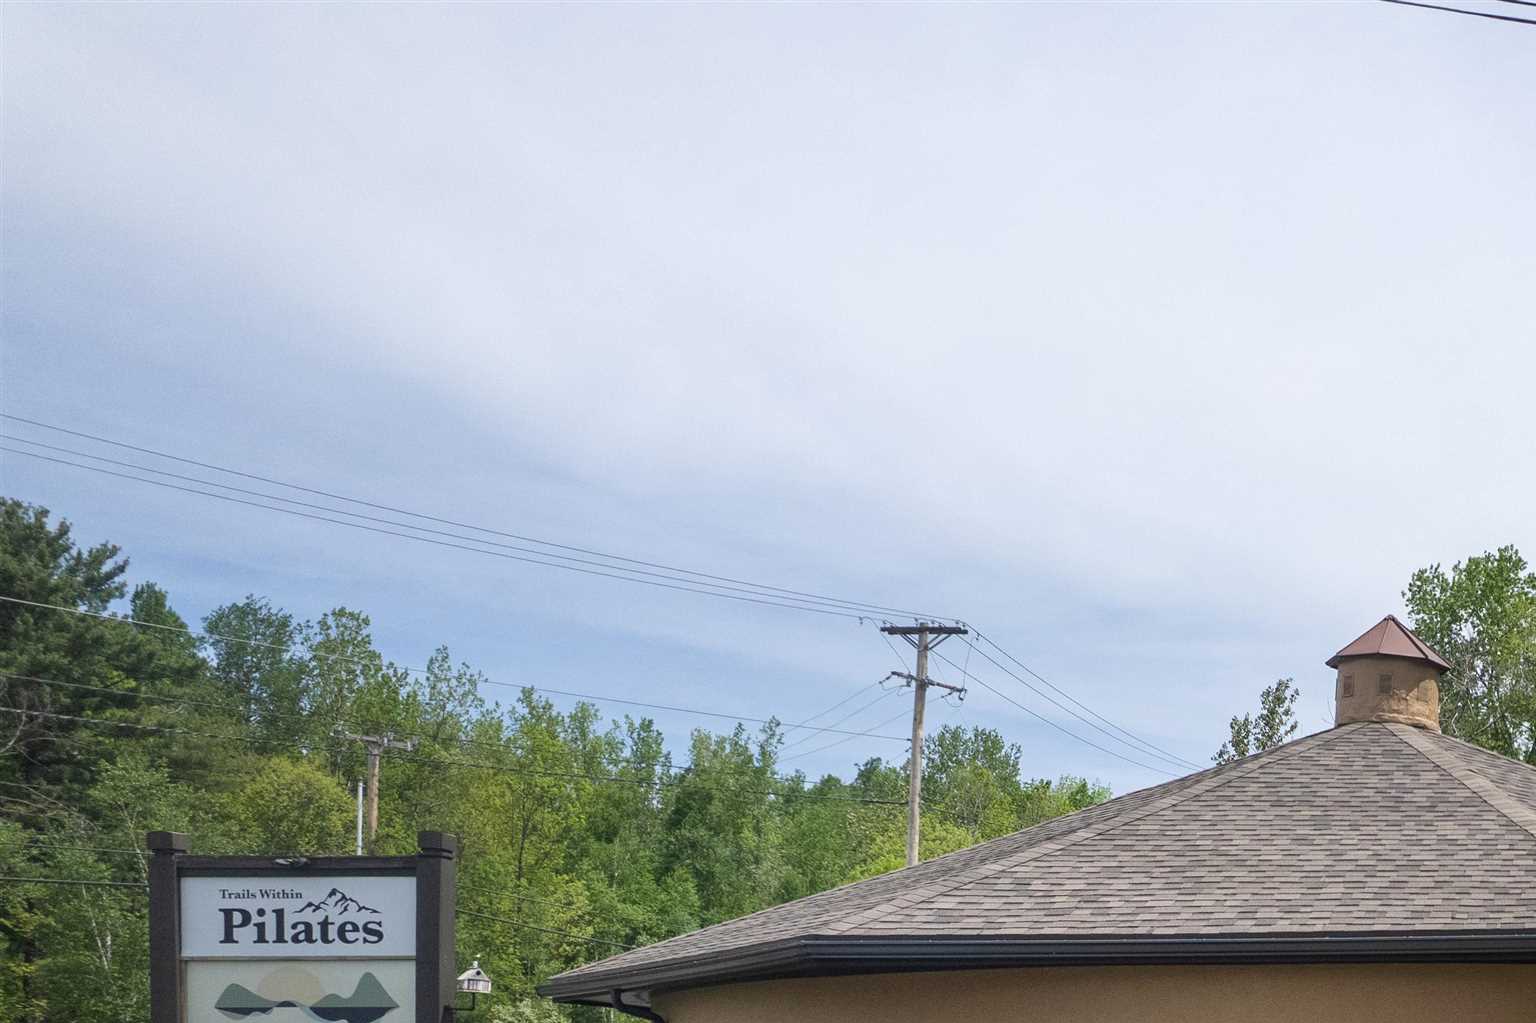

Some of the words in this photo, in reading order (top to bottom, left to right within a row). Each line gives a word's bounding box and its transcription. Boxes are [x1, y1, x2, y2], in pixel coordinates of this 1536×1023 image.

[220, 888, 257, 900] Trails
[259, 888, 303, 900] Within
[218, 907, 384, 945] Pilates
